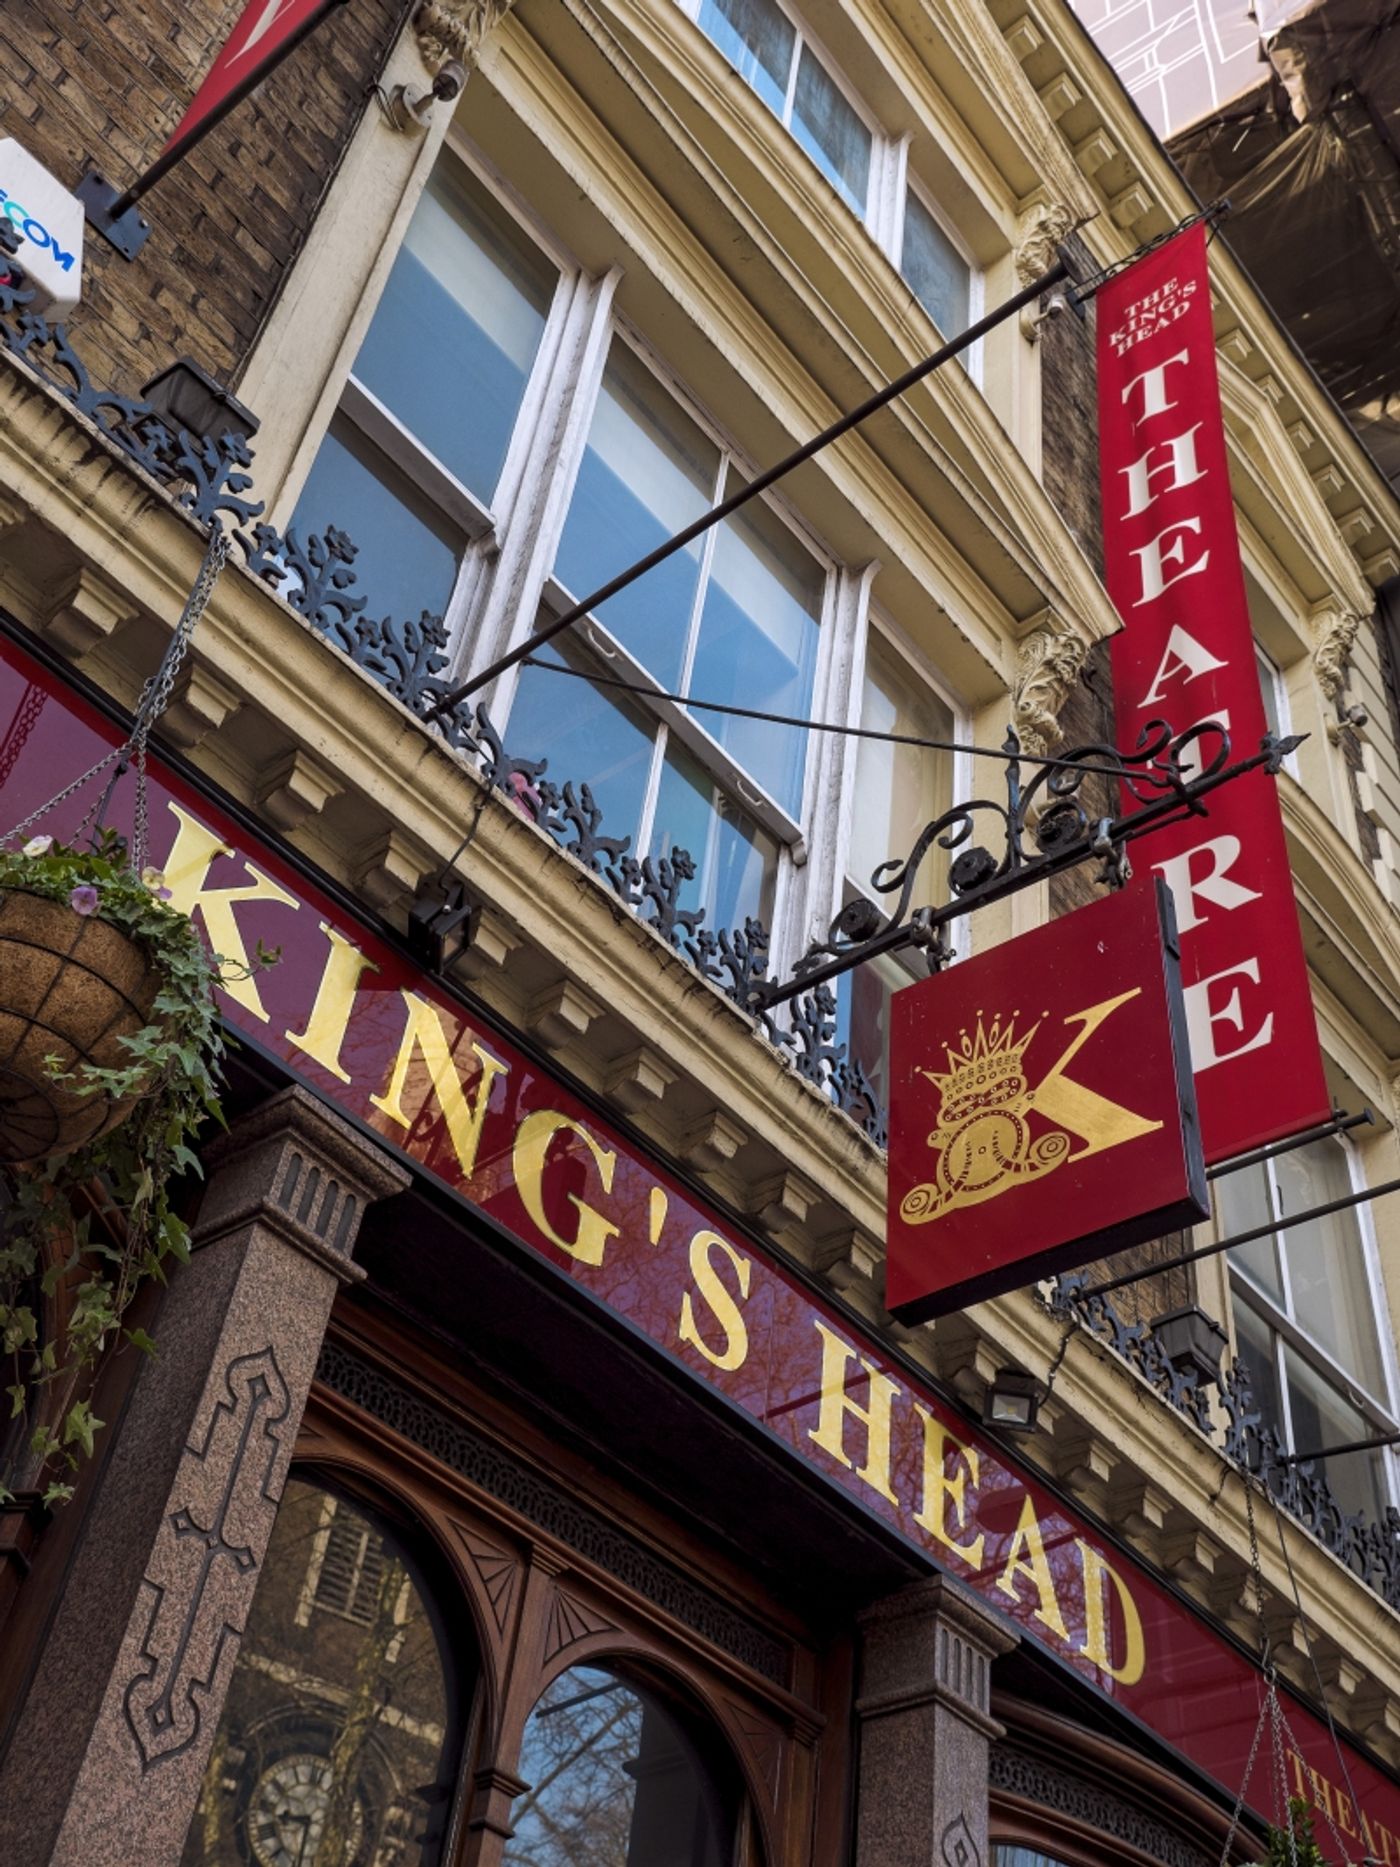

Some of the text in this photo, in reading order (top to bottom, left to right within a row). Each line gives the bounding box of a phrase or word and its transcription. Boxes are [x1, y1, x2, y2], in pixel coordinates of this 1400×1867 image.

[0, 188, 75, 272] COM
[1109, 280, 1197, 347] KING'S
[1117, 301, 1191, 358] HEAD
[1124, 277, 1178, 319] THE
[162, 801, 1146, 1686] KING'S HEAD
[1285, 1748, 1400, 1867] THEAT
